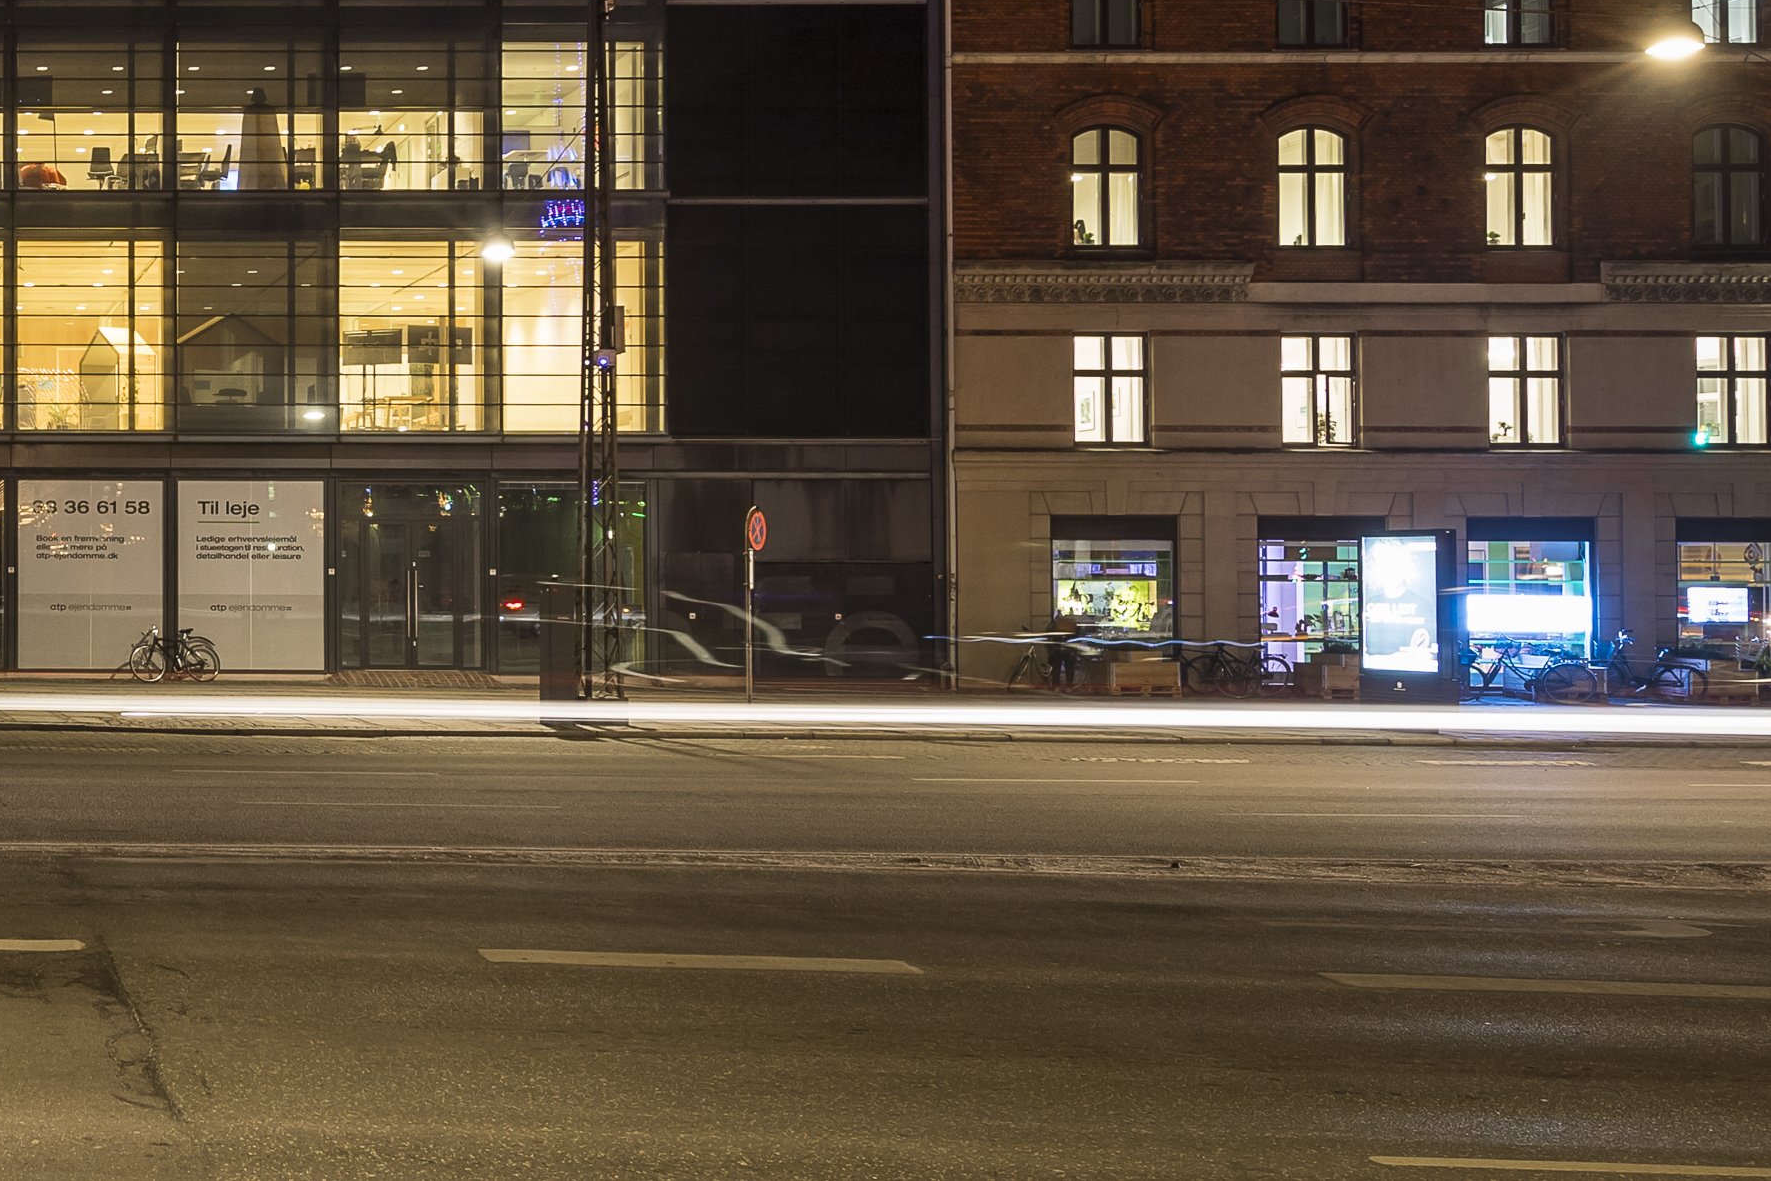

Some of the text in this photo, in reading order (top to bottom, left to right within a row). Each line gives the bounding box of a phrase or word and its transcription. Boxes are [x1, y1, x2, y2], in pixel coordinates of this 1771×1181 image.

[32, 500, 150, 515] 33 36 61 58
[197, 501, 260, 519] Til leje
[36, 534, 59, 542] Book
[196, 535, 226, 544] Ledige
[70, 544, 94, 552] mere
[95, 543, 108, 553] på
[196, 552, 249, 560] detailhandel
[251, 552, 270, 560] eller
[49, 603, 67, 612] atp
[209, 604, 227, 613] atp
